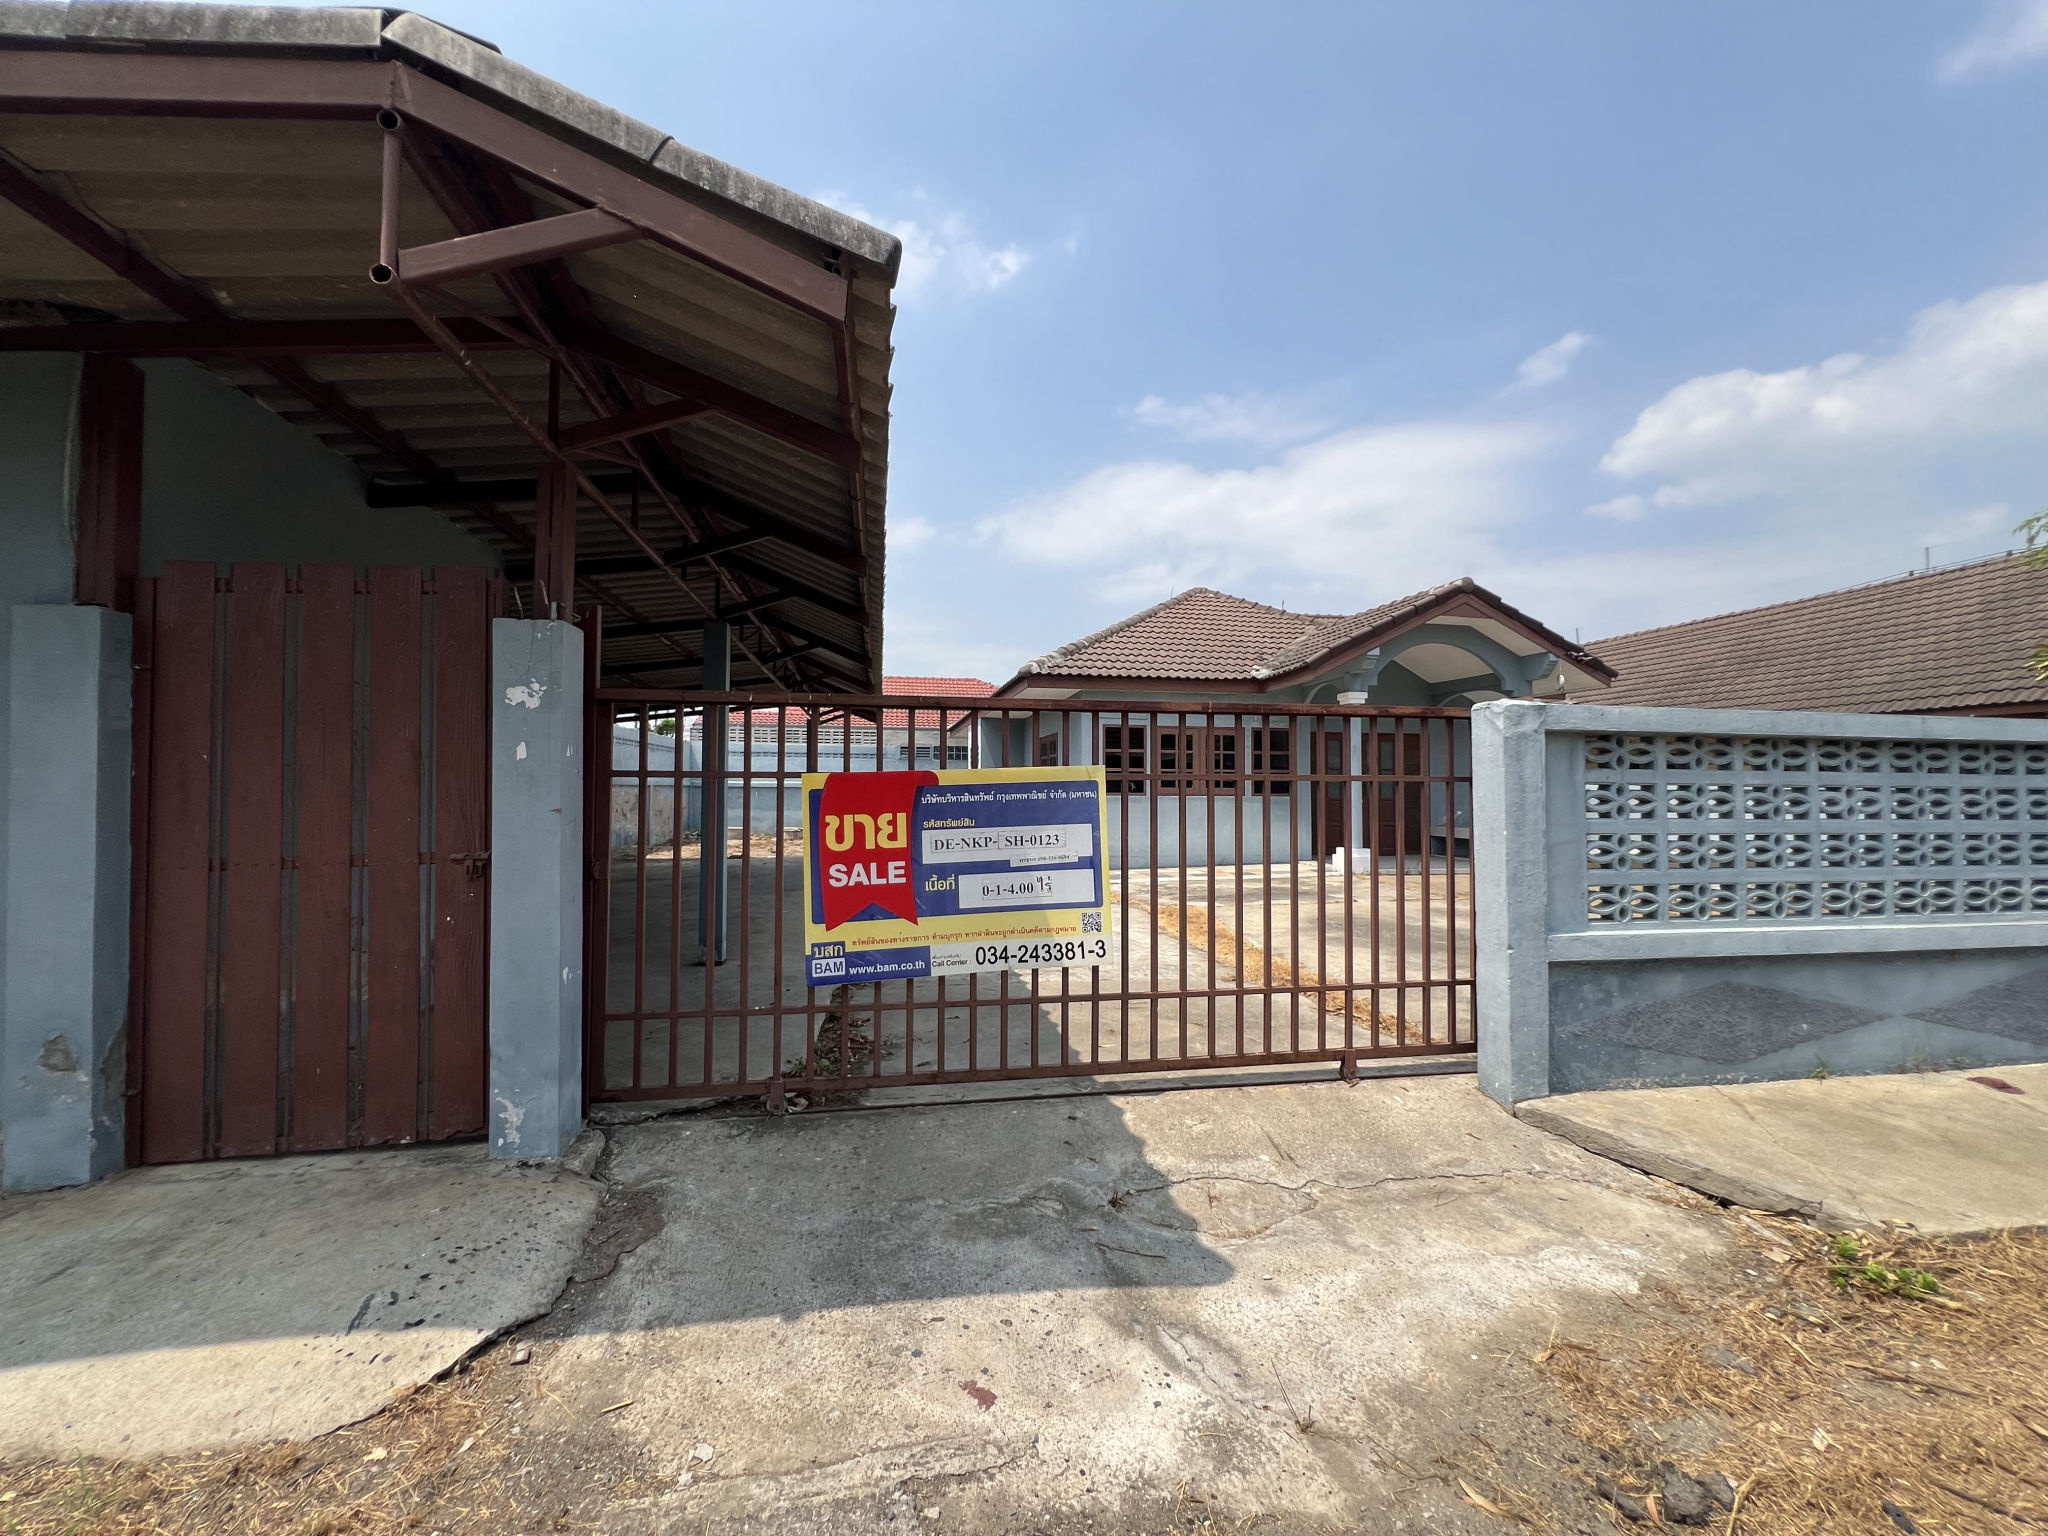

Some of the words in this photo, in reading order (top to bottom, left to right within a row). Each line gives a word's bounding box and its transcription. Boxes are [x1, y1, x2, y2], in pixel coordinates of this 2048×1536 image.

[1069, 789, 1098, 800] (มหาชน)
[923, 818, 975, 829] รหัสทรัพย์สิน
[825, 812, 907, 852] ขาย
[1005, 833, 1060, 847] SH-0123
[829, 861, 906, 887] SALE
[925, 874, 955, 892] เนื้อที่
[982, 882, 1034, 897] 0-1-4.00
[813, 944, 844, 958] บสก
[931, 960, 945, 968] Call
[945, 959, 969, 967] Center
[975, 939, 1107, 966] 034-243381-3
[814, 962, 844, 975] BAM
[849, 960, 926, 975] www.bam.co.th
